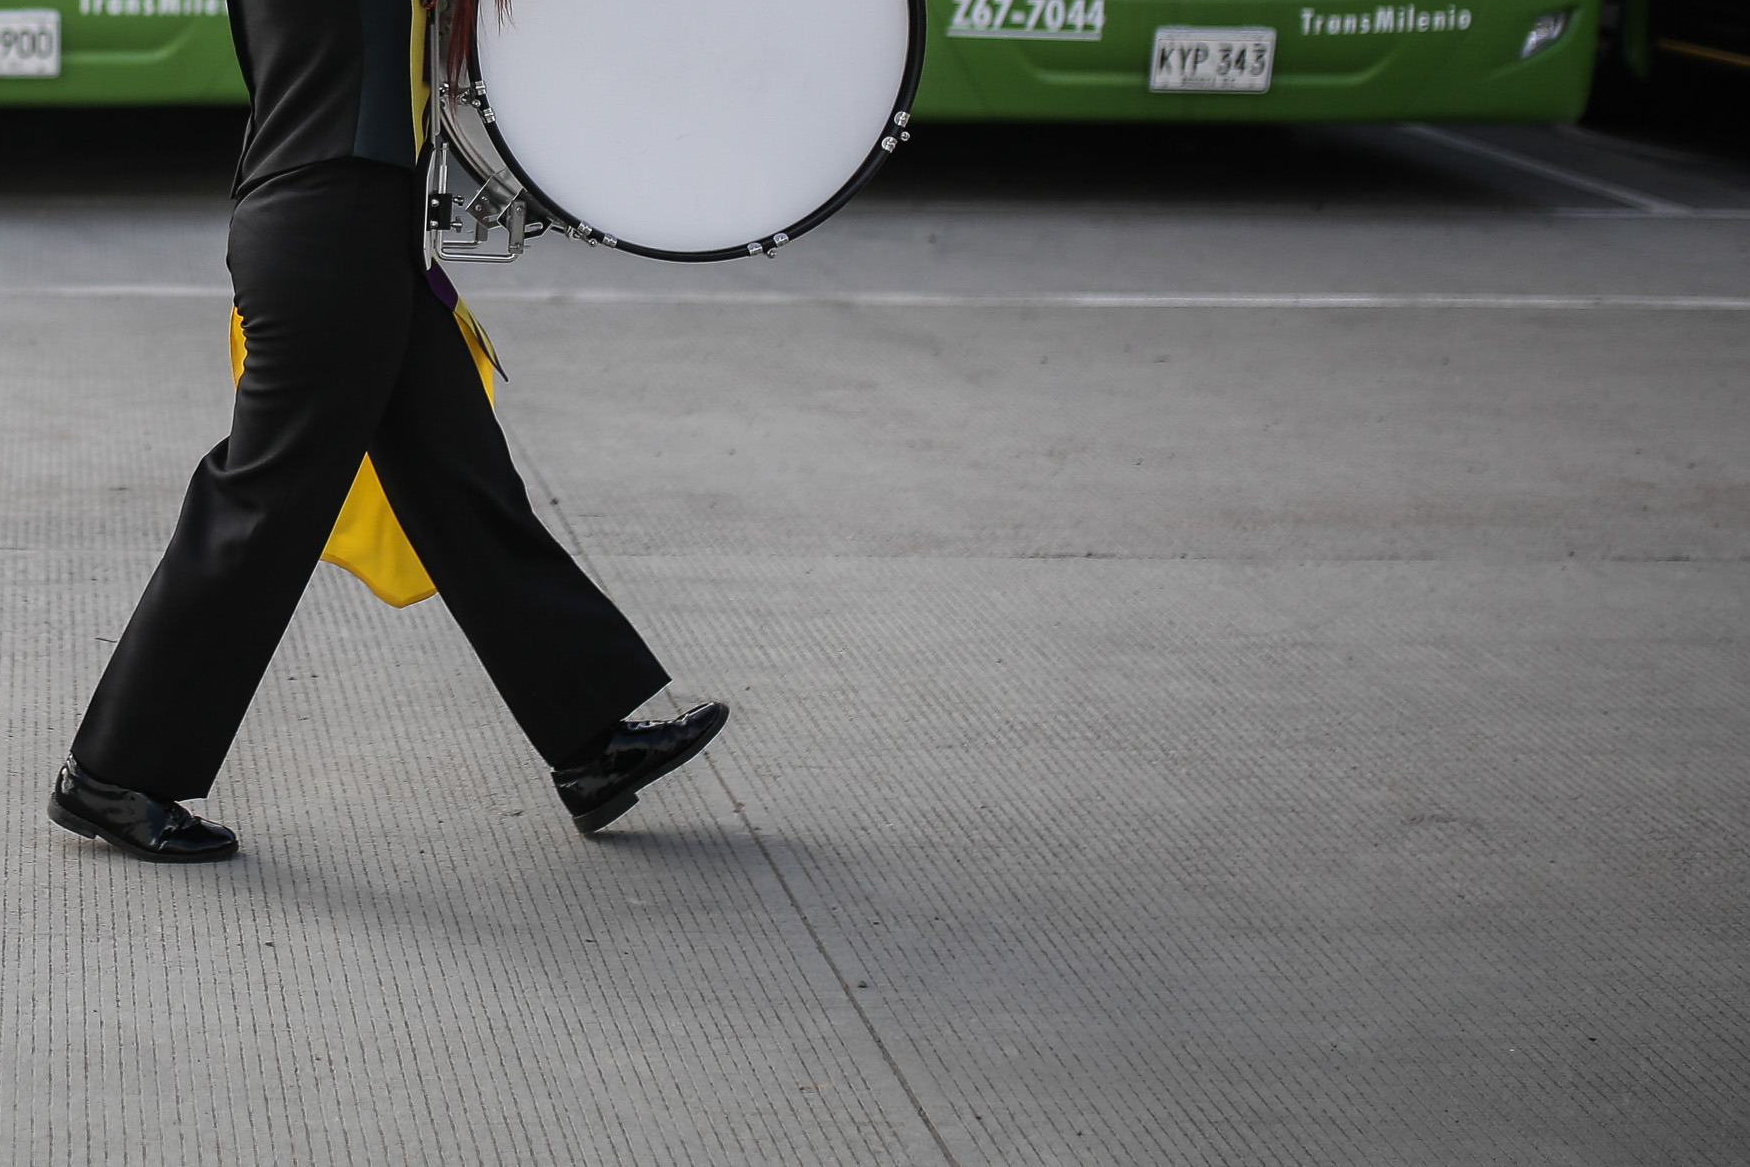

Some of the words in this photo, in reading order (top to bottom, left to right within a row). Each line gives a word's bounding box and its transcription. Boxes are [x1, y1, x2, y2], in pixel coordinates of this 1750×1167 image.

[1300, 7, 1472, 36] TransMilenio
[0, 28, 53, 61] 900
[1158, 42, 1209, 76] KYP
[1216, 42, 1266, 76] 343
